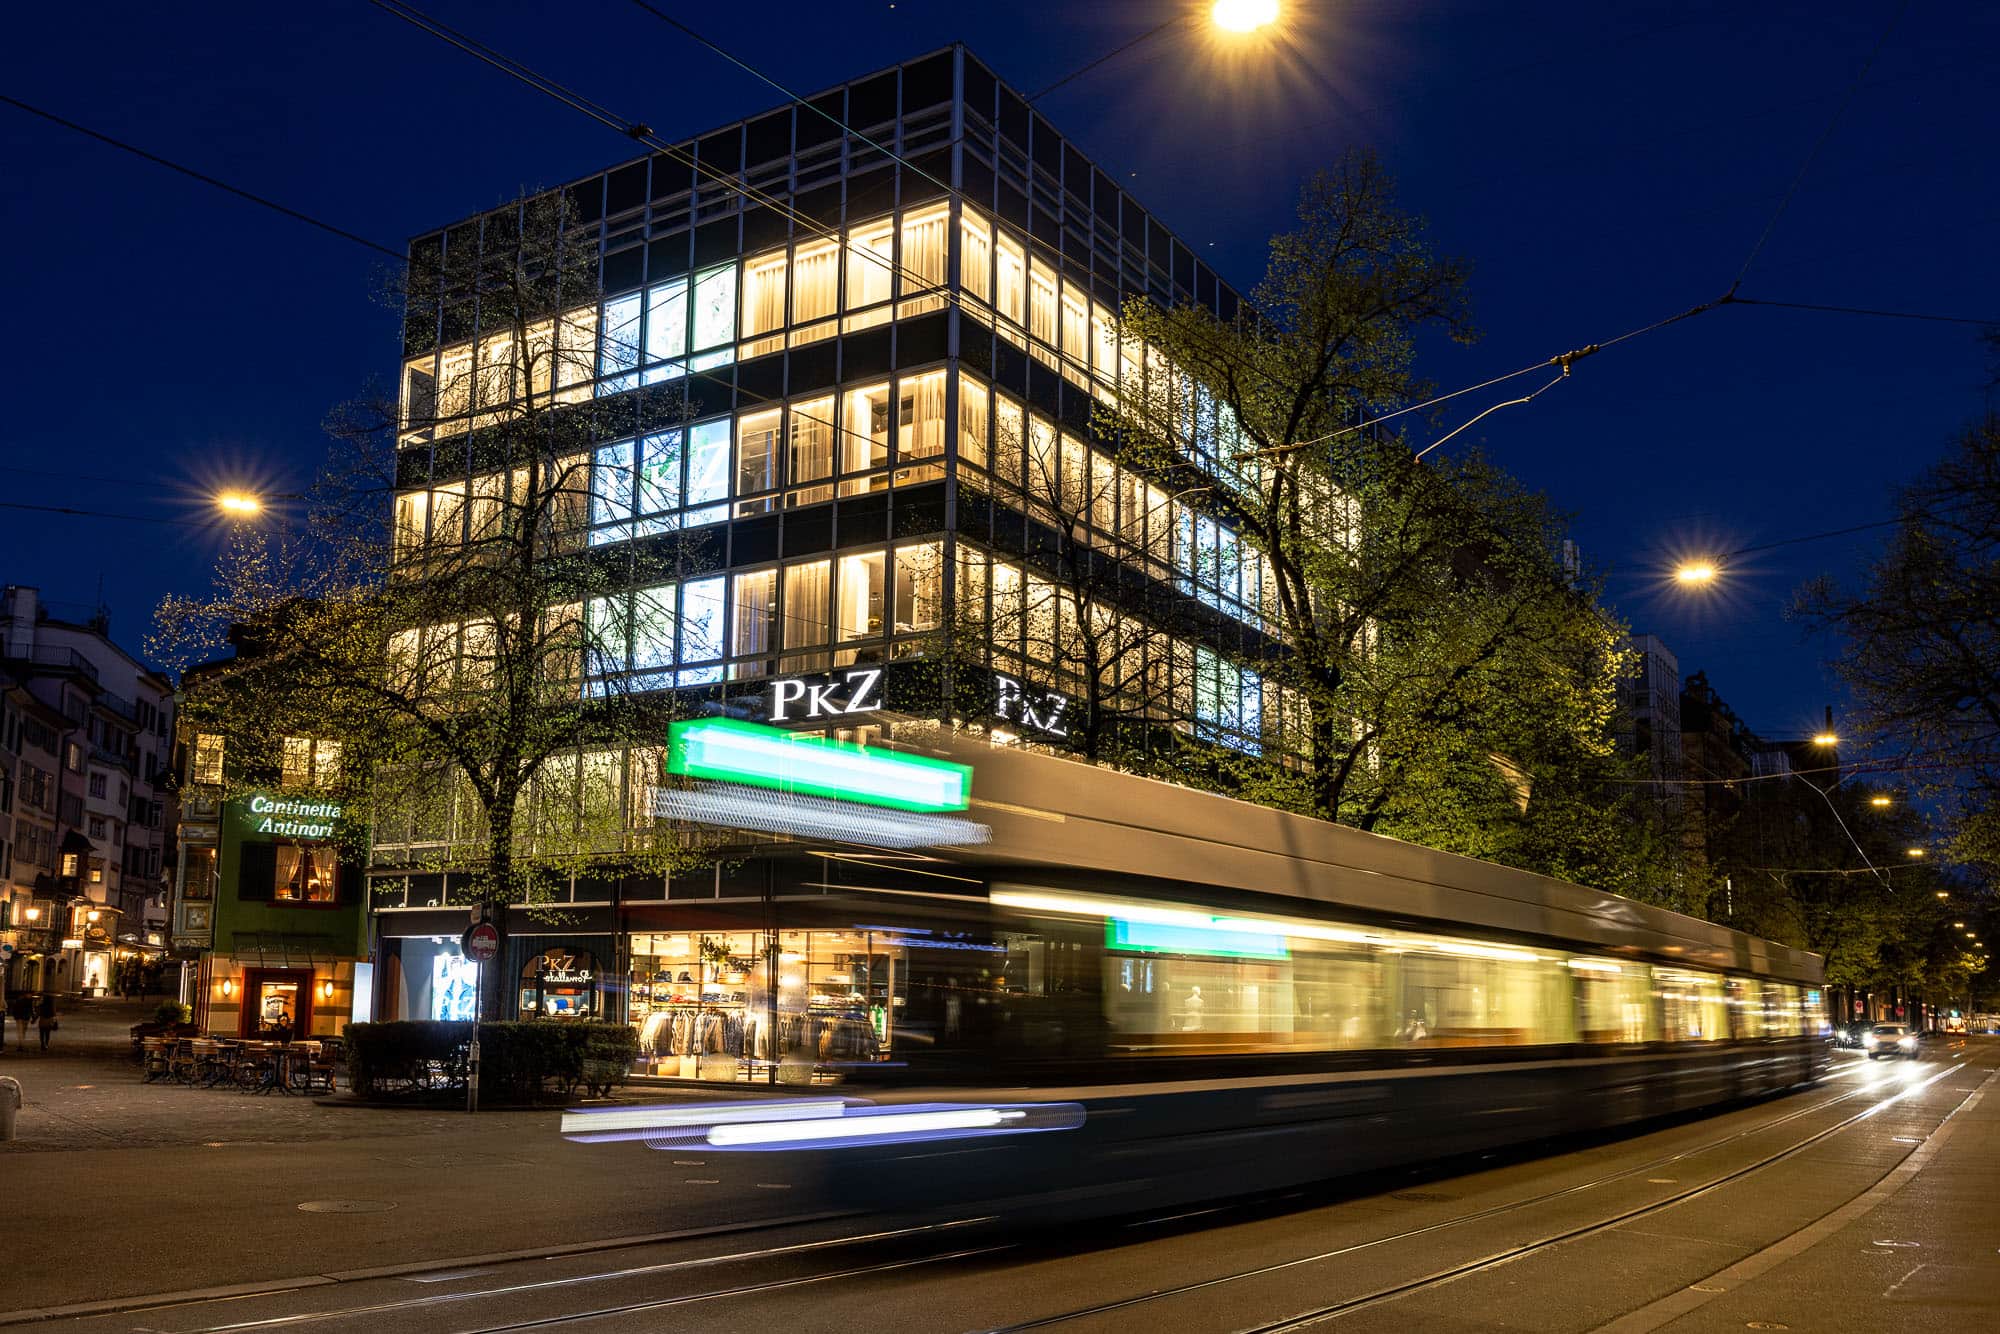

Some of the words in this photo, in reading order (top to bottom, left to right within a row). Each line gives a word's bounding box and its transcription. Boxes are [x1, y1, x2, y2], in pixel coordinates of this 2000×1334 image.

[769, 669, 881, 722] PKZ
[251, 797, 342, 818] Cantinetta
[259, 817, 334, 837] Antinori
